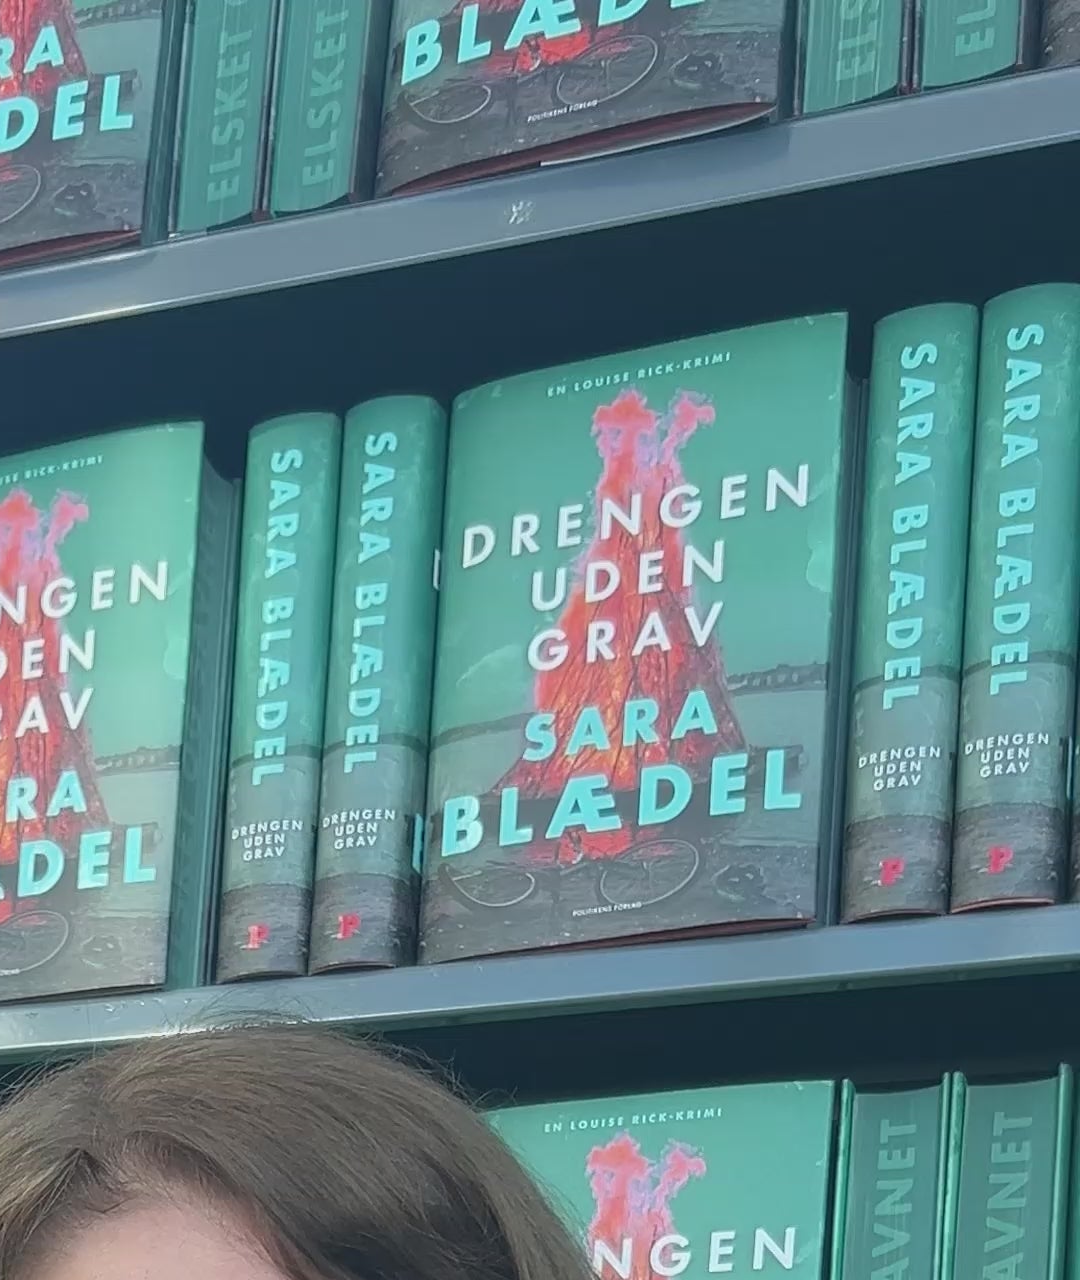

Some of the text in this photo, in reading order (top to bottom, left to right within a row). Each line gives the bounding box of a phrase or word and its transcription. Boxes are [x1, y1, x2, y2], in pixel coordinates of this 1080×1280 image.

[547, 386, 566, 397] EN
[574, 372, 629, 392] LOUISE
[462, 464, 810, 569] DRENGEN
[990, 323, 1044, 696] SARA BLÆDEL
[882, 343, 938, 710] SARA BLÆDEL
[530, 540, 725, 613] UDEN
[343, 432, 398, 773] SARA BLÆDEL
[252, 449, 303, 786] SARA BLÆDEL
[526, 603, 723, 673] GRAV
[522, 691, 718, 762] SARA
[964, 732, 1050, 756] DRENGEN
[980, 747, 1031, 763] UDEN
[858, 746, 942, 768] DRENGEN
[873, 760, 922, 776] UDEN
[979, 760, 1031, 777] GRAV
[873, 773, 922, 791] GRAV
[441, 749, 802, 858] BLÆDEL
[322, 808, 396, 827] DRENGEN
[231, 818, 303, 840] DRENGEN
[334, 822, 379, 837] UDEN
[243, 833, 286, 848] UDEN
[333, 834, 378, 850] GRAV
[243, 846, 286, 861] GRAV
[545, 1123, 562, 1132] EN
[570, 1117, 624, 1130] LOUISE
